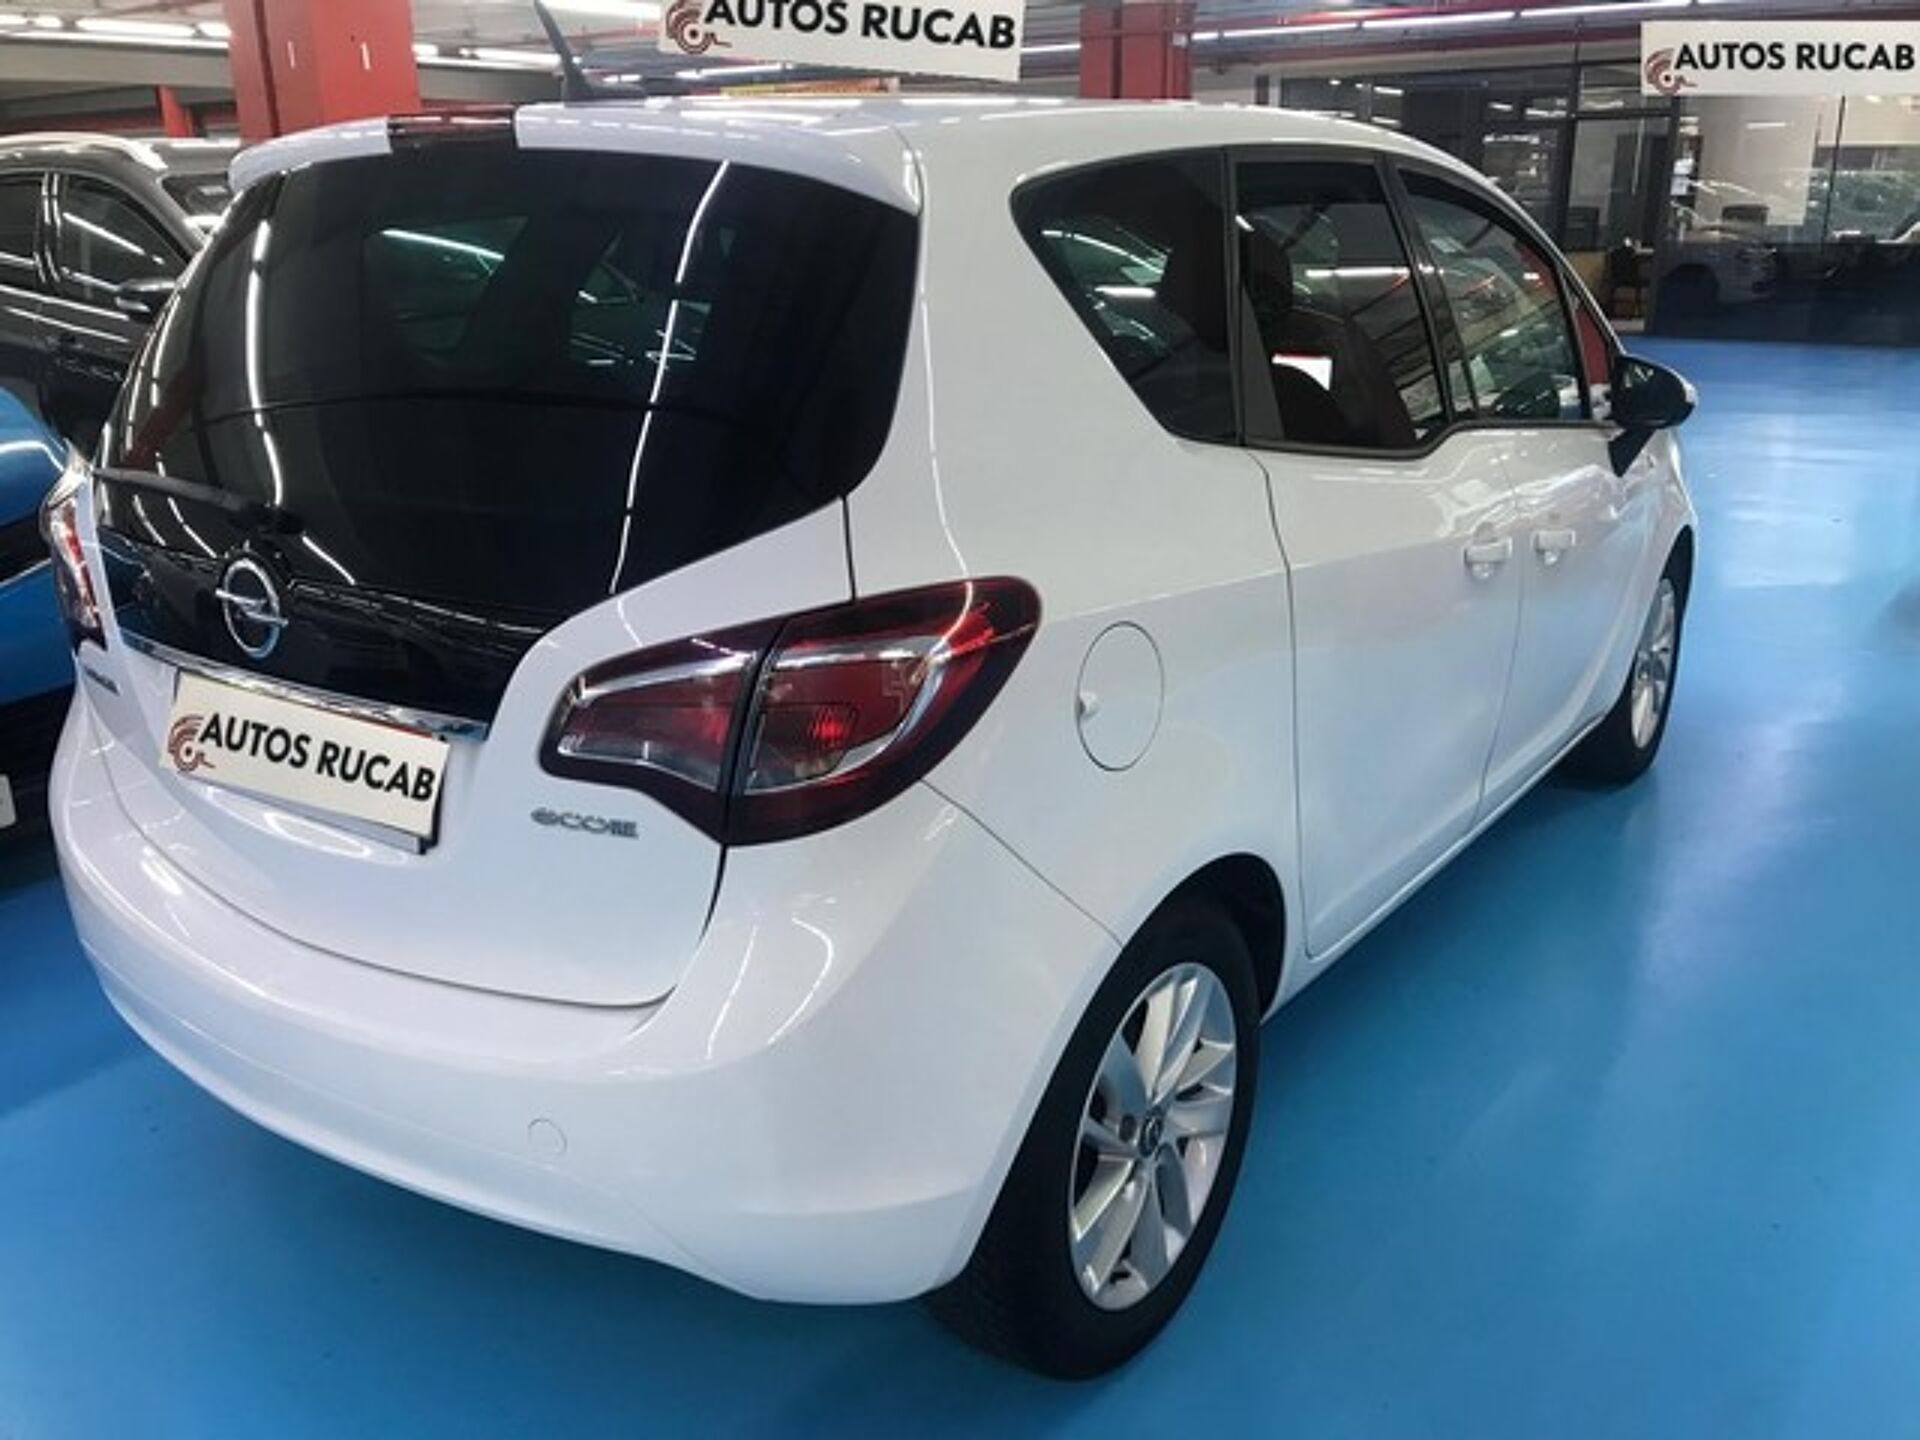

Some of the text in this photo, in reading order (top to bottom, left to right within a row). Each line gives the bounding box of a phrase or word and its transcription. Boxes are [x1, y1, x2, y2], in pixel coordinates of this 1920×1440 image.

[705, 0, 1015, 49] AUTOS RUCAB
[1675, 42, 1915, 70] AUTOS RUCAB
[200, 713, 435, 801] AUTOS RUCAB
